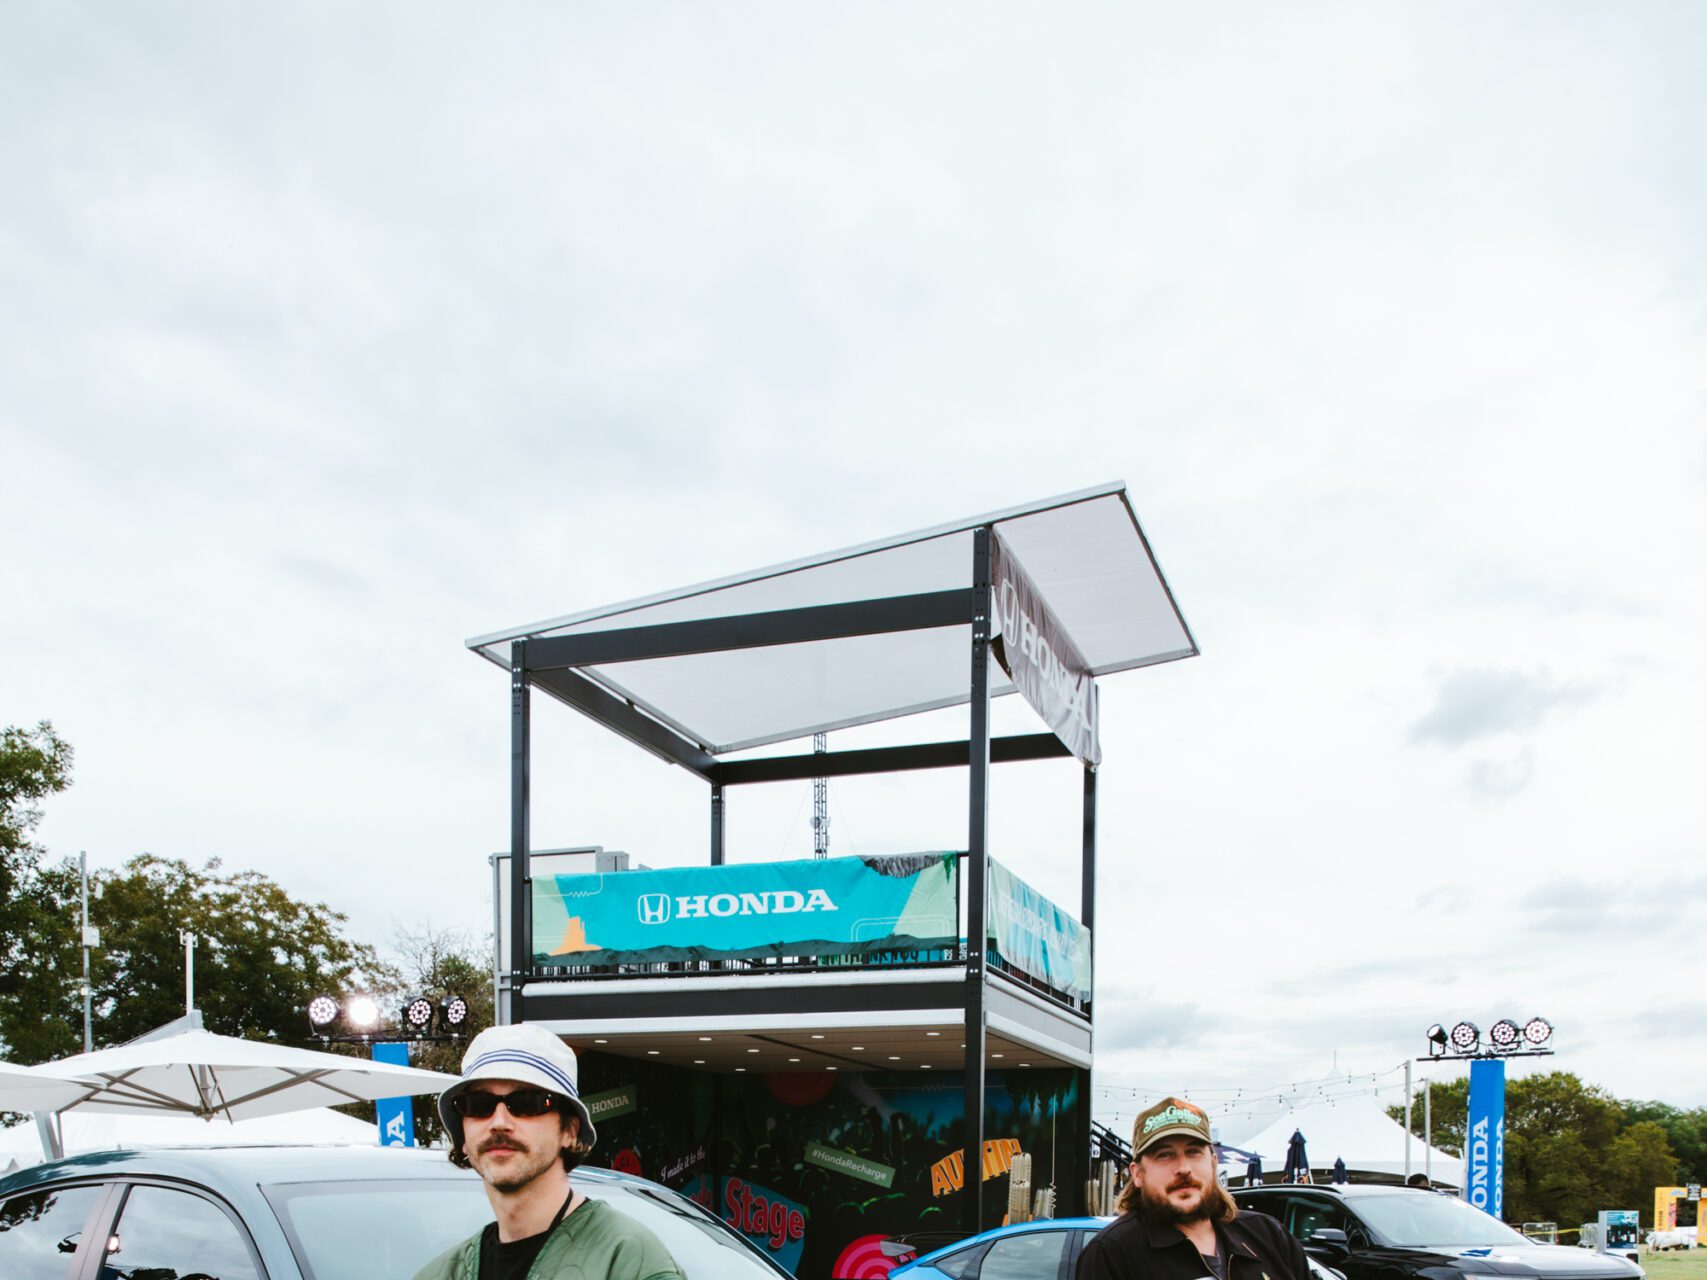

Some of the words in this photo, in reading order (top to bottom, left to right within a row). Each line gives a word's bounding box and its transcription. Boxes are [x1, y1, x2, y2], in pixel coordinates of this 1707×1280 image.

[675, 888, 838, 918] HONDA
[591, 1094, 629, 1115] HONDA
[812, 1149, 887, 1181] #HondaRecharge
[931, 1138, 1022, 1197] AUTIN
[1472, 1115, 1489, 1212] ONDA
[726, 1177, 805, 1248] Stage
